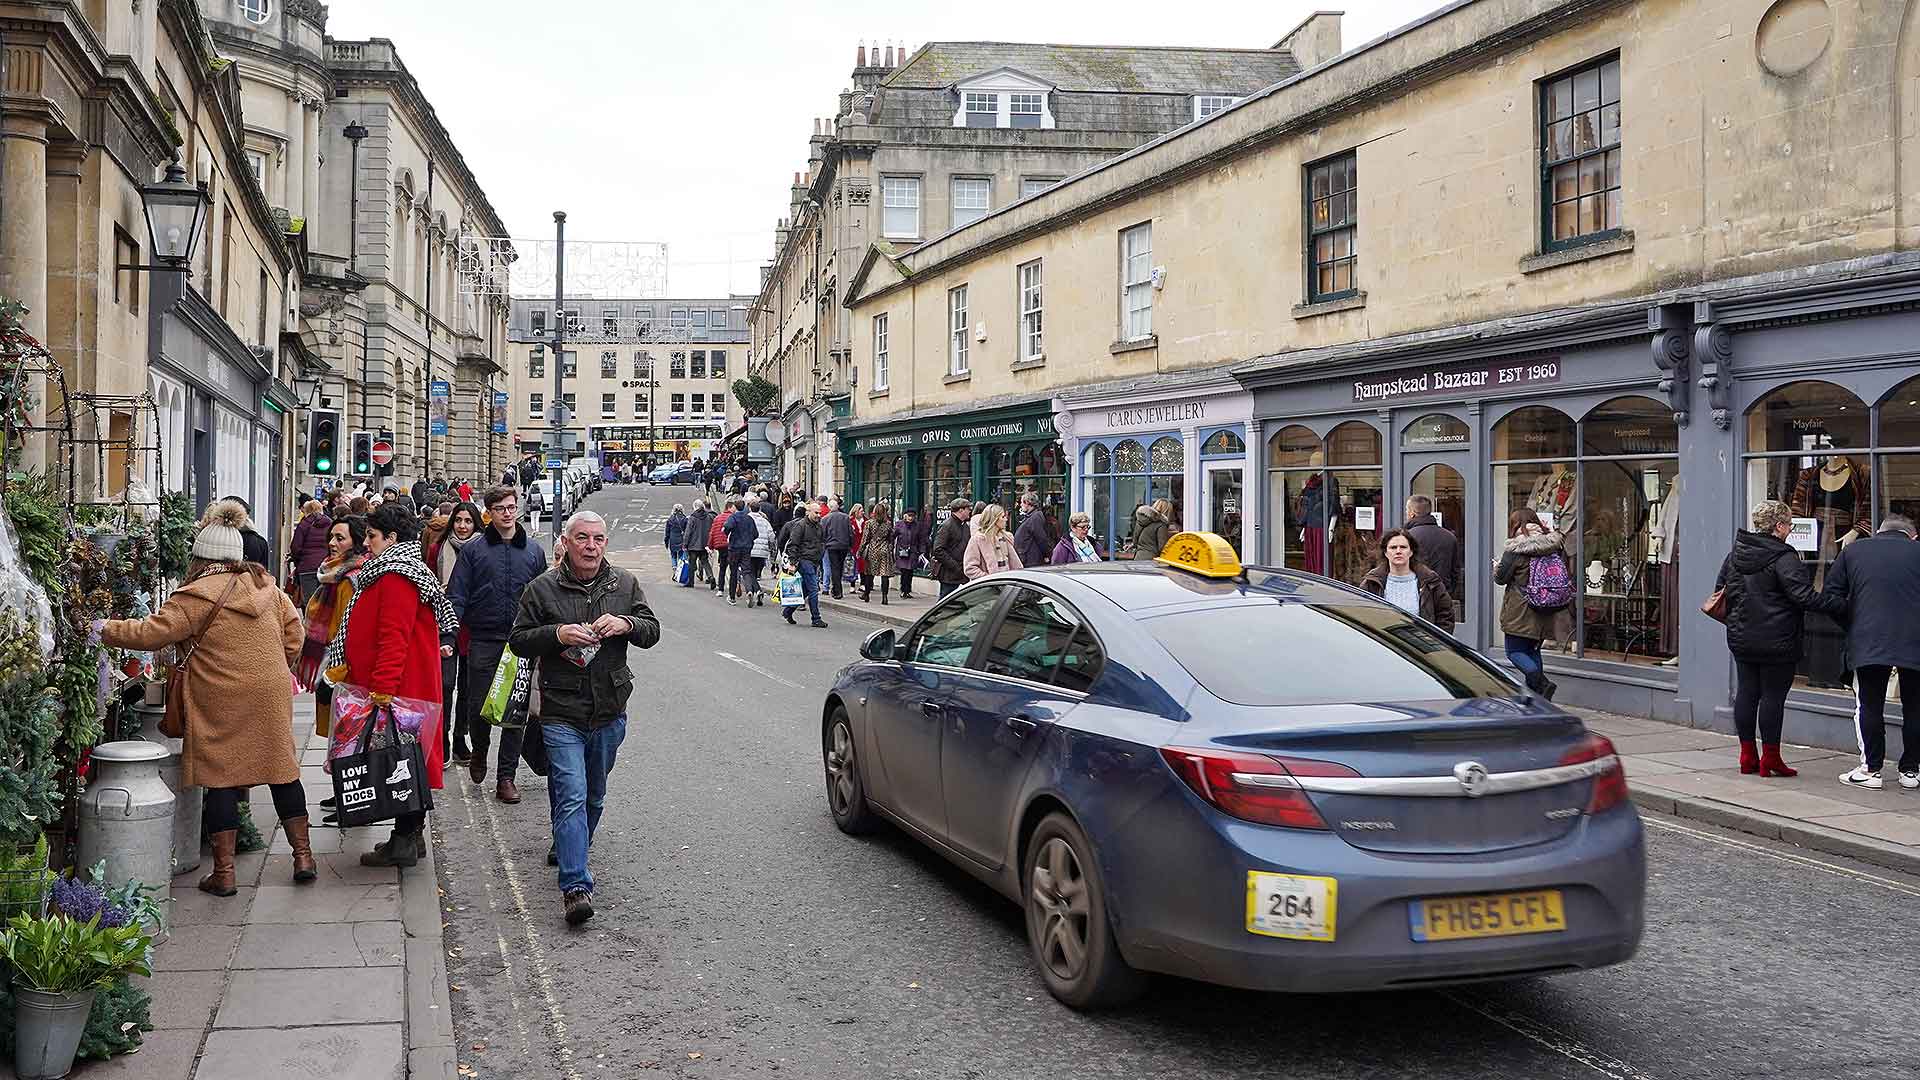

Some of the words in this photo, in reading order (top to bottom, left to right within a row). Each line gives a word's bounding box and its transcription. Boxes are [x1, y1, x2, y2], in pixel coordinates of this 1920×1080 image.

[1433, 371, 1489, 390] Bazaar
[1498, 367, 1523, 384] EST
[1527, 363, 1557, 380] 1960
[1106, 408, 1143, 428] ICARUS
[1144, 401, 1207, 424] JEWELLERY
[922, 430, 951, 444] ORVIS
[960, 427, 988, 439] COUNTRY
[989, 422, 1023, 436] CLOTHING
[1792, 419, 1824, 431] Mayfair
[1178, 545, 1200, 563] 264
[341, 764, 368, 779] LOVE
[343, 779, 361, 791] MY
[345, 789, 373, 803] DOCS
[1269, 893, 1313, 919] 264
[1430, 900, 1501, 934] FH65
[1510, 896, 1561, 927] CFL
